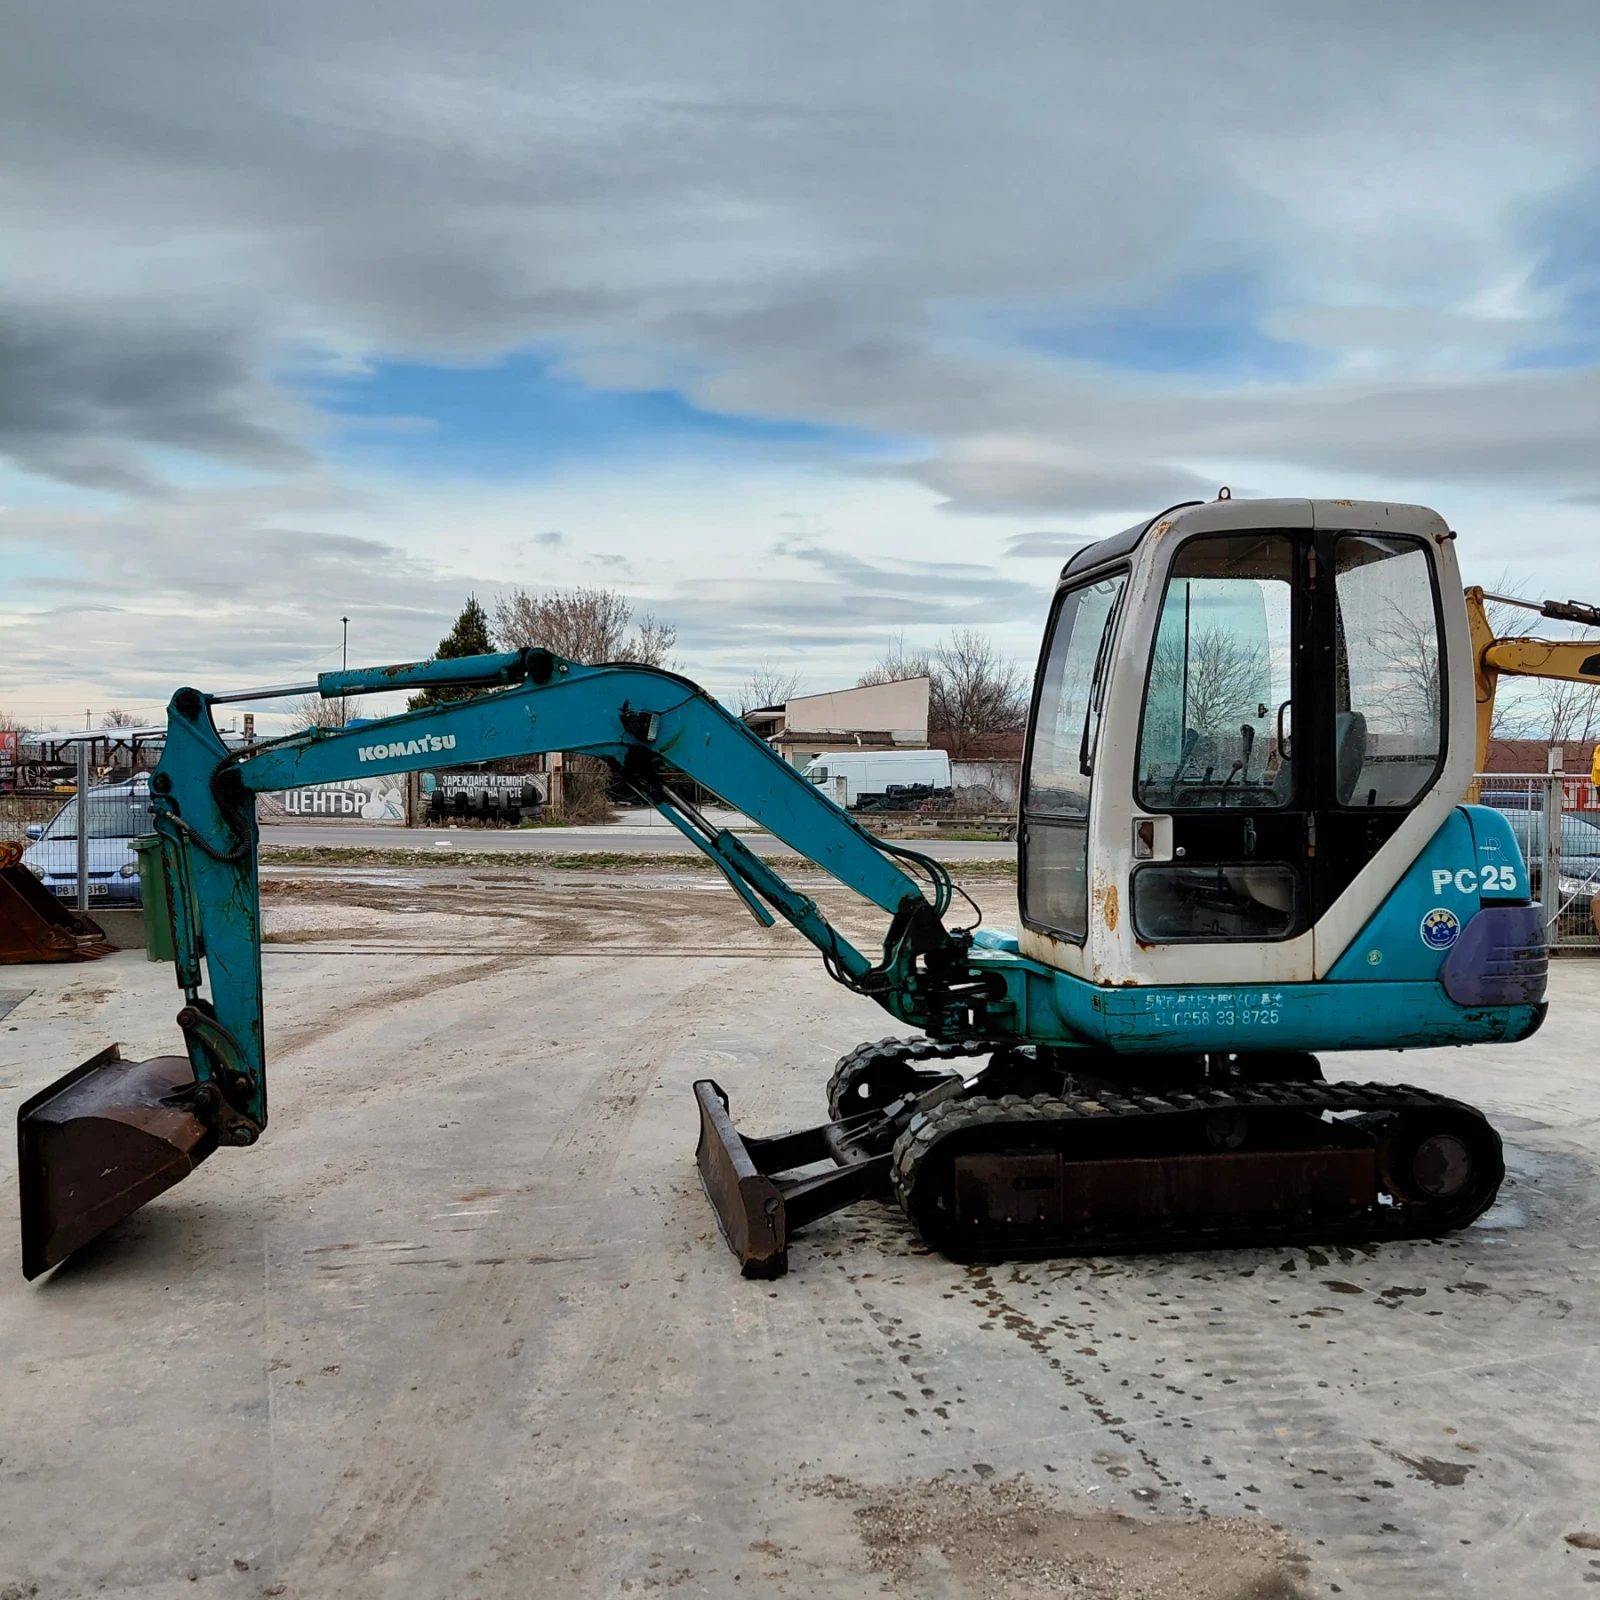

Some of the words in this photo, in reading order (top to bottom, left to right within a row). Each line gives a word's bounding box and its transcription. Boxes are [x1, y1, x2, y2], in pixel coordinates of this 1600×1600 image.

[358, 734, 456, 762] KOMATSU
[442, 775, 489, 787] ЗАРЕЖДАНЕ
[497, 775, 526, 787] РЕМОНТ
[285, 791, 367, 814] ЦЕНТЪР
[71, 885, 93, 895] 13
